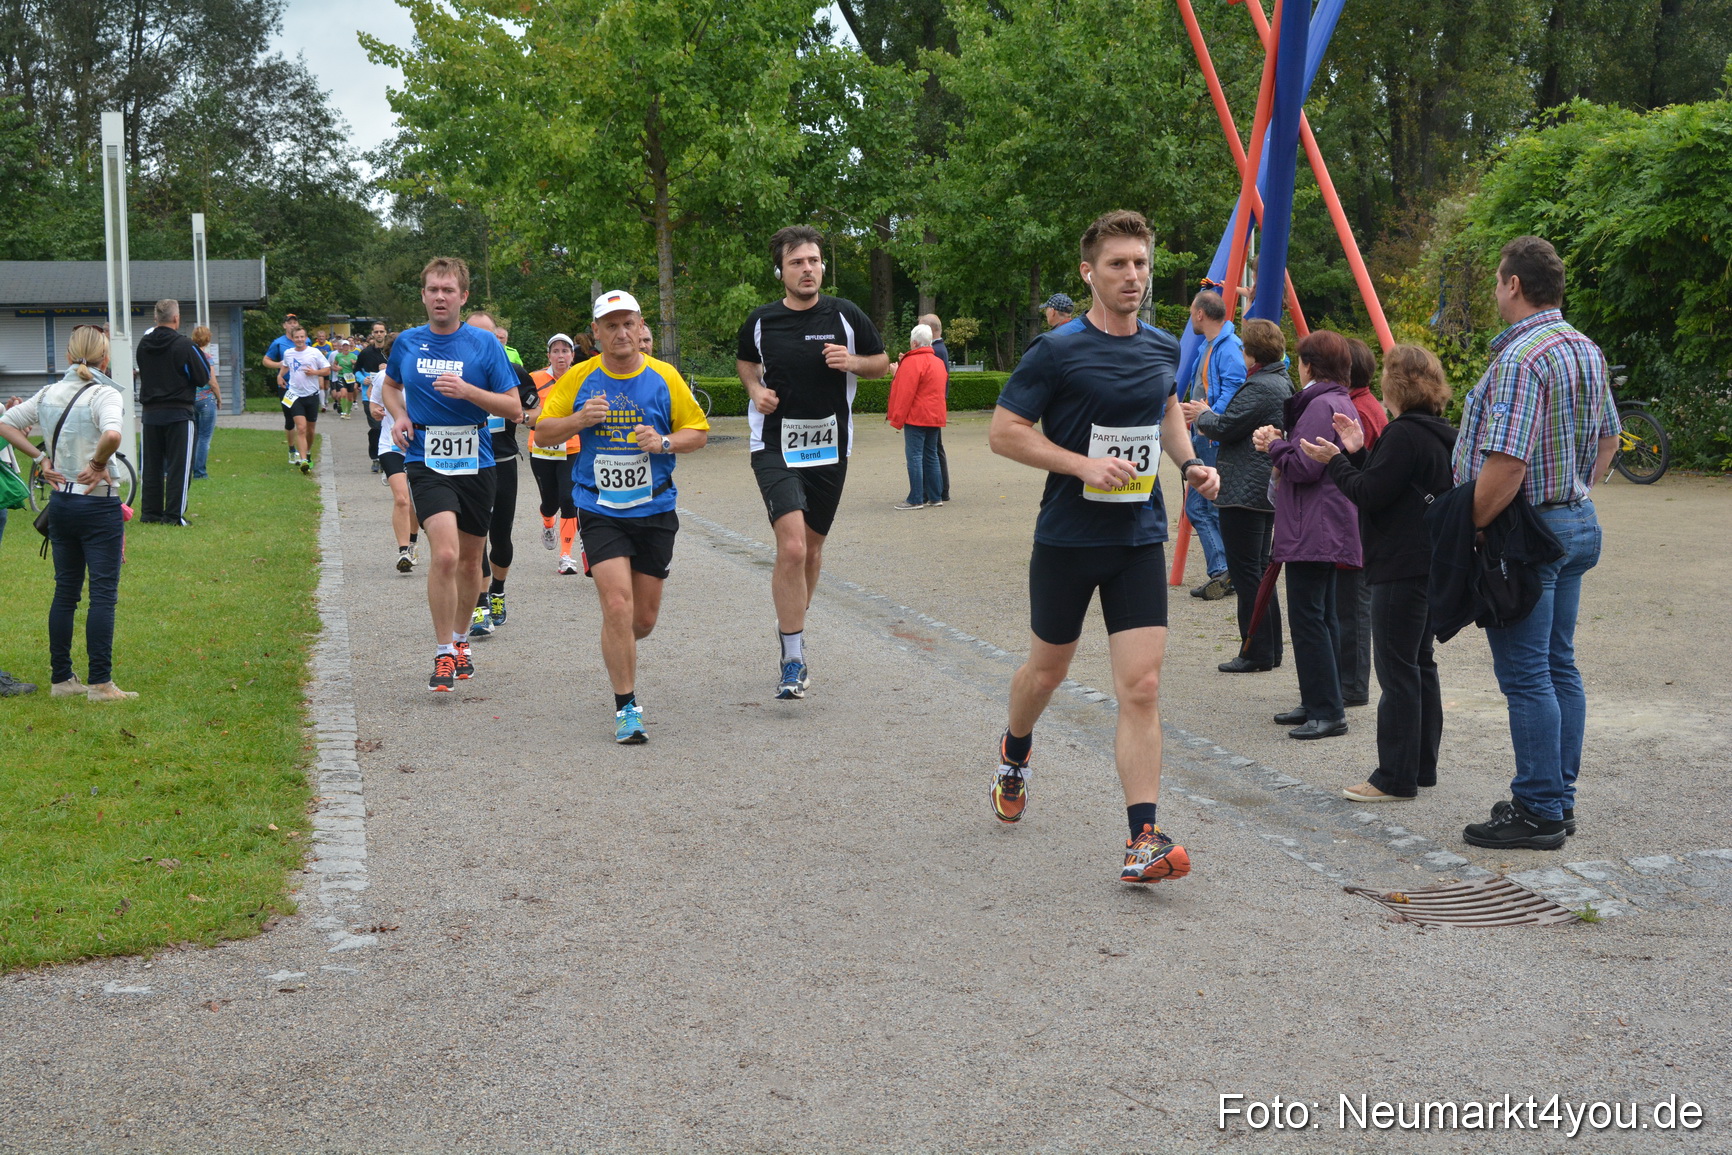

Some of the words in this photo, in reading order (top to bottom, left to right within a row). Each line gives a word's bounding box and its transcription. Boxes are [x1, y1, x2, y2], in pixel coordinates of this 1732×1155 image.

[416, 358, 464, 371] HUBER
[802, 422, 829, 430] Neumarkt
[787, 428, 834, 449] 2144
[1092, 432, 1120, 443] PARTL
[1121, 433, 1154, 443] Neumarkt
[430, 437, 473, 456] 2911
[800, 450, 821, 460] Bernd
[595, 459, 613, 467] PARTL
[614, 459, 642, 467] Neumarkt
[600, 465, 648, 489] 3382
